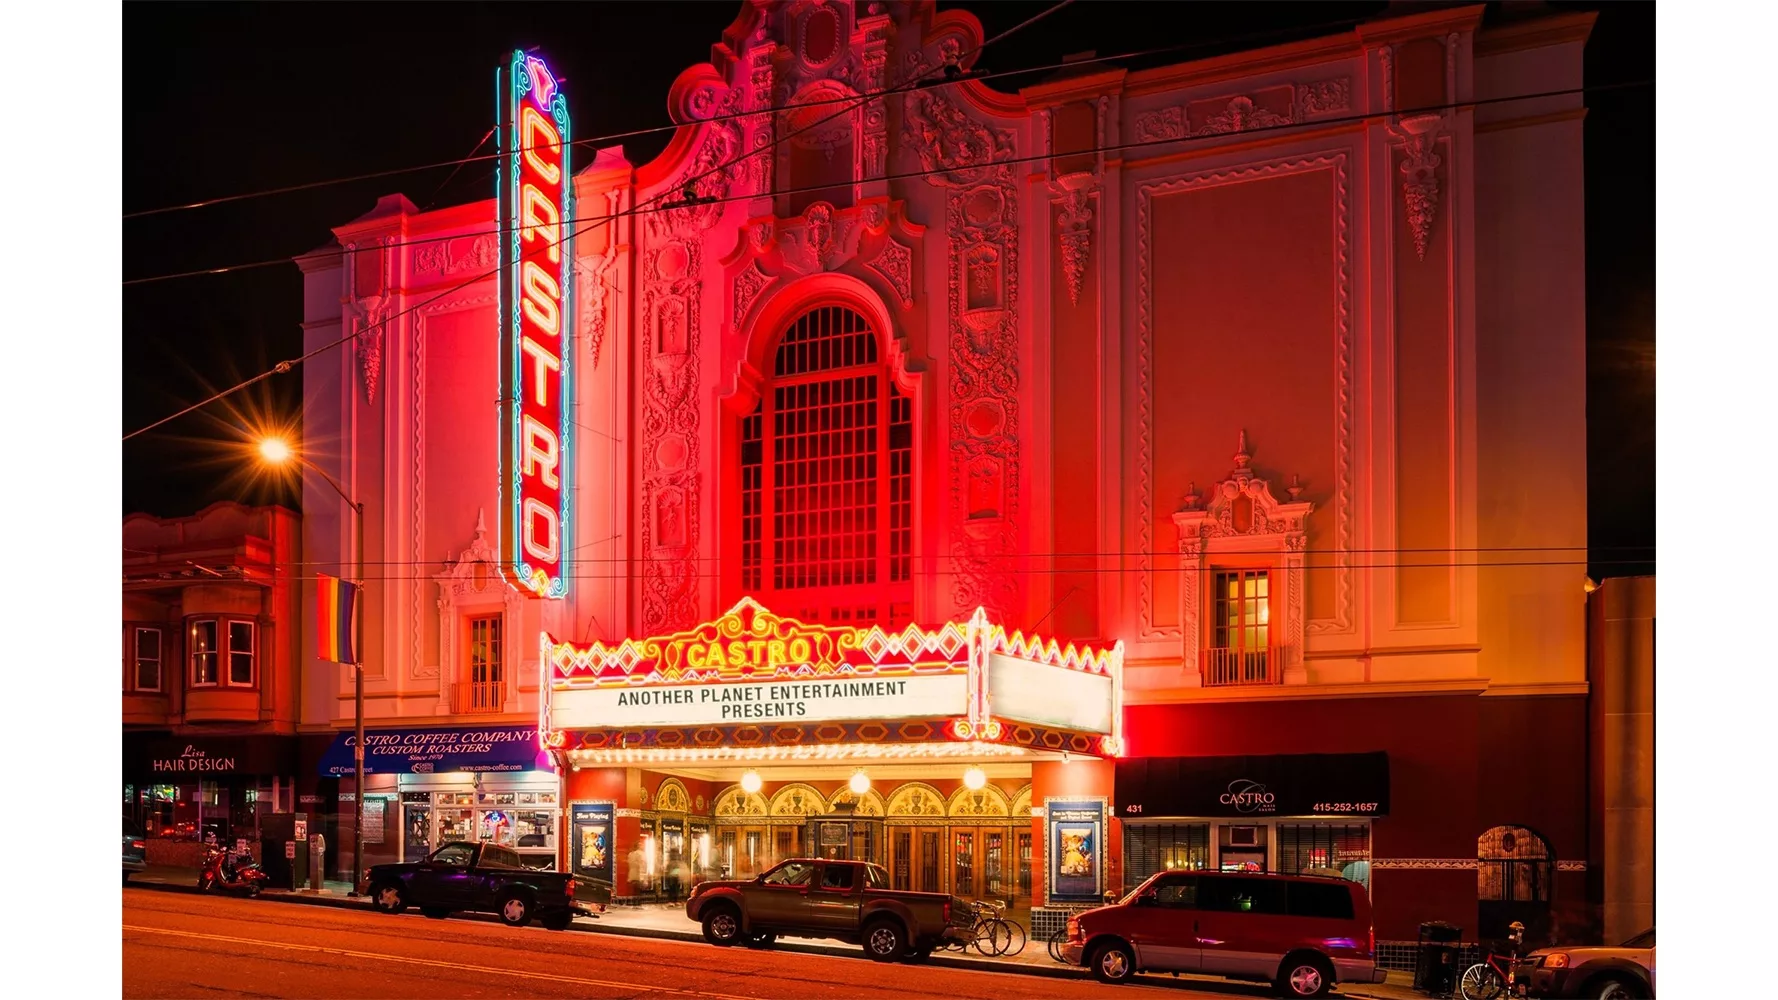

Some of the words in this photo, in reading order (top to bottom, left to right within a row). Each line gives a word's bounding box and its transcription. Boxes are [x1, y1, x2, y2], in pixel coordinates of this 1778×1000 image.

[521, 105, 561, 565] CASTRO
[687, 638, 811, 667] CASTRO
[618, 689, 694, 706] ANOTHER
[701, 686, 763, 702] PLANET
[770, 681, 907, 700] ENTERTAINMENT
[721, 702, 806, 718] PRESENTS
[403, 732, 460, 745] COFFEE
[461, 730, 537, 743] COMPANY
[181, 744, 205, 758] Lisa
[372, 745, 424, 755] CUSTOM
[426, 743, 492, 754] ROASTERS
[153, 759, 185, 771] HAIR
[189, 757, 235, 771] DESIGN
[459, 763, 523, 771] www.castro-coffee.com
[1219, 792, 1275, 805] CASTRO
[1126, 804, 1142, 813] 431
[1313, 802, 1378, 812] 415-252-1657
